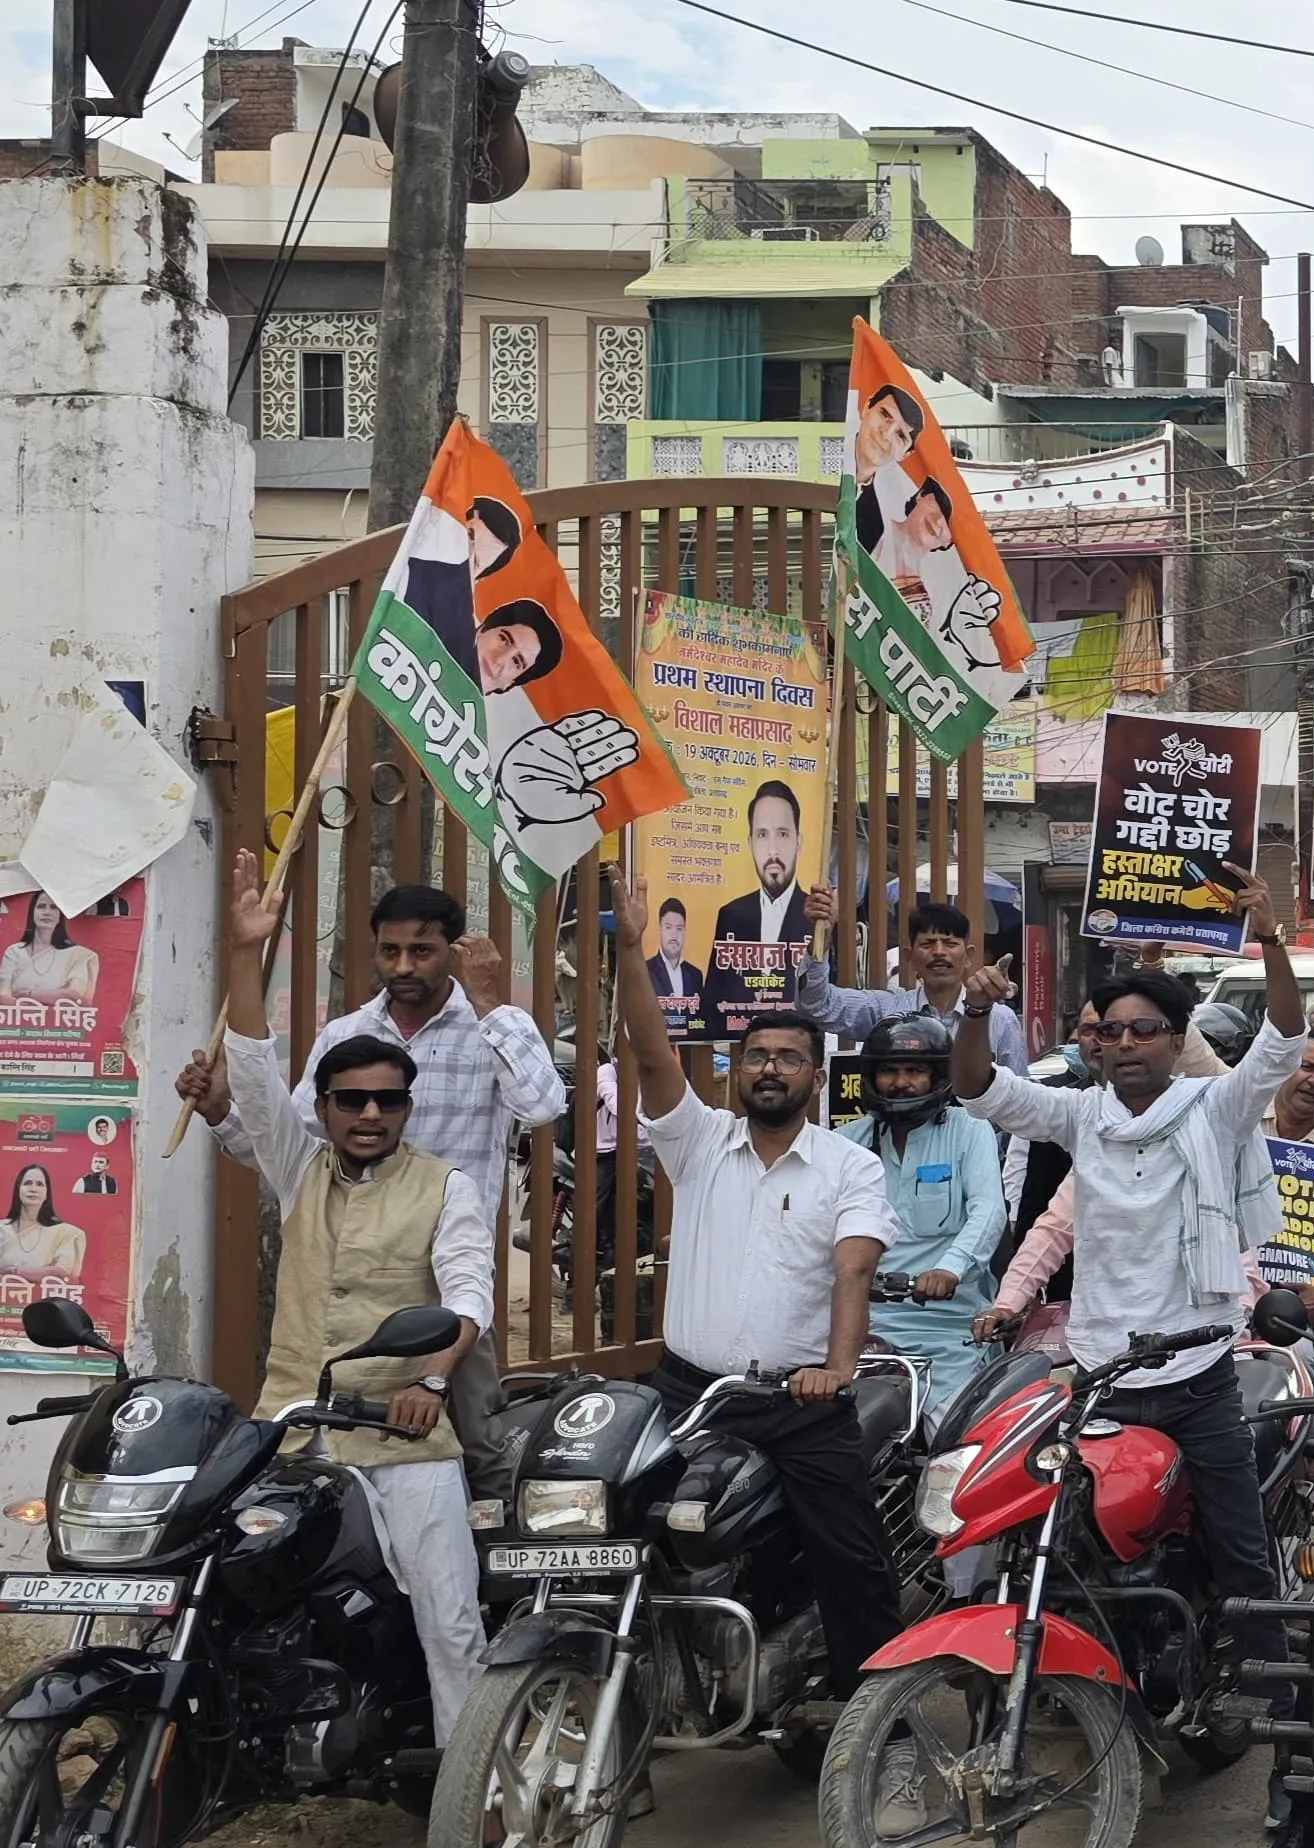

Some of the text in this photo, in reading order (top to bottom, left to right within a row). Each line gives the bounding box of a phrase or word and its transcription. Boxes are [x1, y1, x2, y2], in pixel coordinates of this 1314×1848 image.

[653, 662, 814, 708] प्रथम स्थापना दिवस
[673, 700, 793, 746] विशाल महाप्रसाद
[684, 743, 697, 758] 19
[699, 746, 730, 768] अक्टूबर
[787, 751, 817, 773] सोमवार
[1133, 758, 1177, 776] VOTE
[1197, 753, 1233, 776] चोरी
[1123, 782, 1231, 821] वोट चोर
[1116, 816, 1232, 859] गद्दी छोड़
[1102, 849, 1184, 879] हस्ताक्षर
[1096, 874, 1184, 905] अभियान
[1120, 921, 1143, 934] जिला
[714, 932, 787, 972] हंसराज
[53, 998, 98, 1031] सिंह
[1274, 1158, 1294, 1169] VOTE
[1258, 1247, 1310, 1268] GNATURE
[1258, 1267, 1312, 1285] MPAIGN
[508, 1549, 632, 1568] UP 72AA 8860
[23, 1580, 170, 1602] UP 72CK 7126
